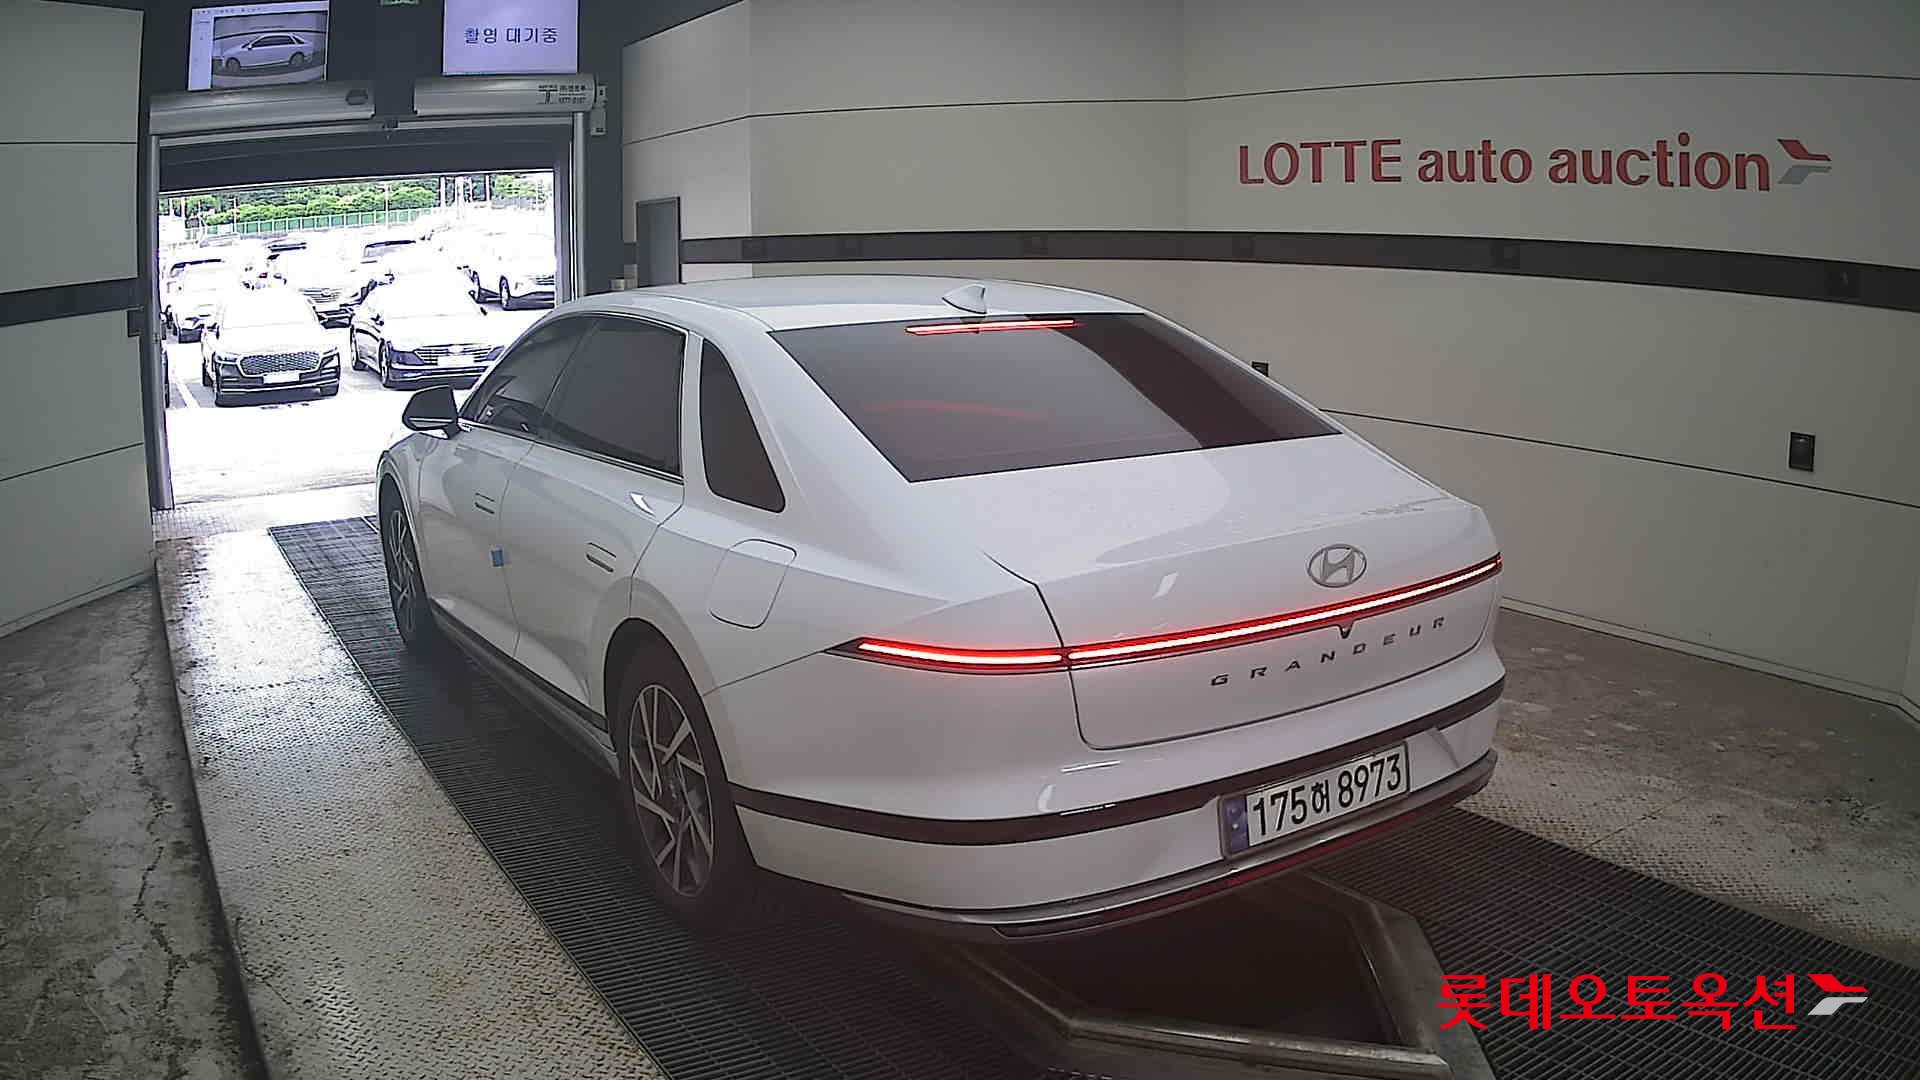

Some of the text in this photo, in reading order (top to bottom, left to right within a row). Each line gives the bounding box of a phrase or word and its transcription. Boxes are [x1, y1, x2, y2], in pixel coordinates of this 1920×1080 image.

[505, 27, 559, 44] 대기중
[1238, 131, 1771, 192] LOTTE auto auction
[1210, 616, 1445, 687] GRANDEUR
